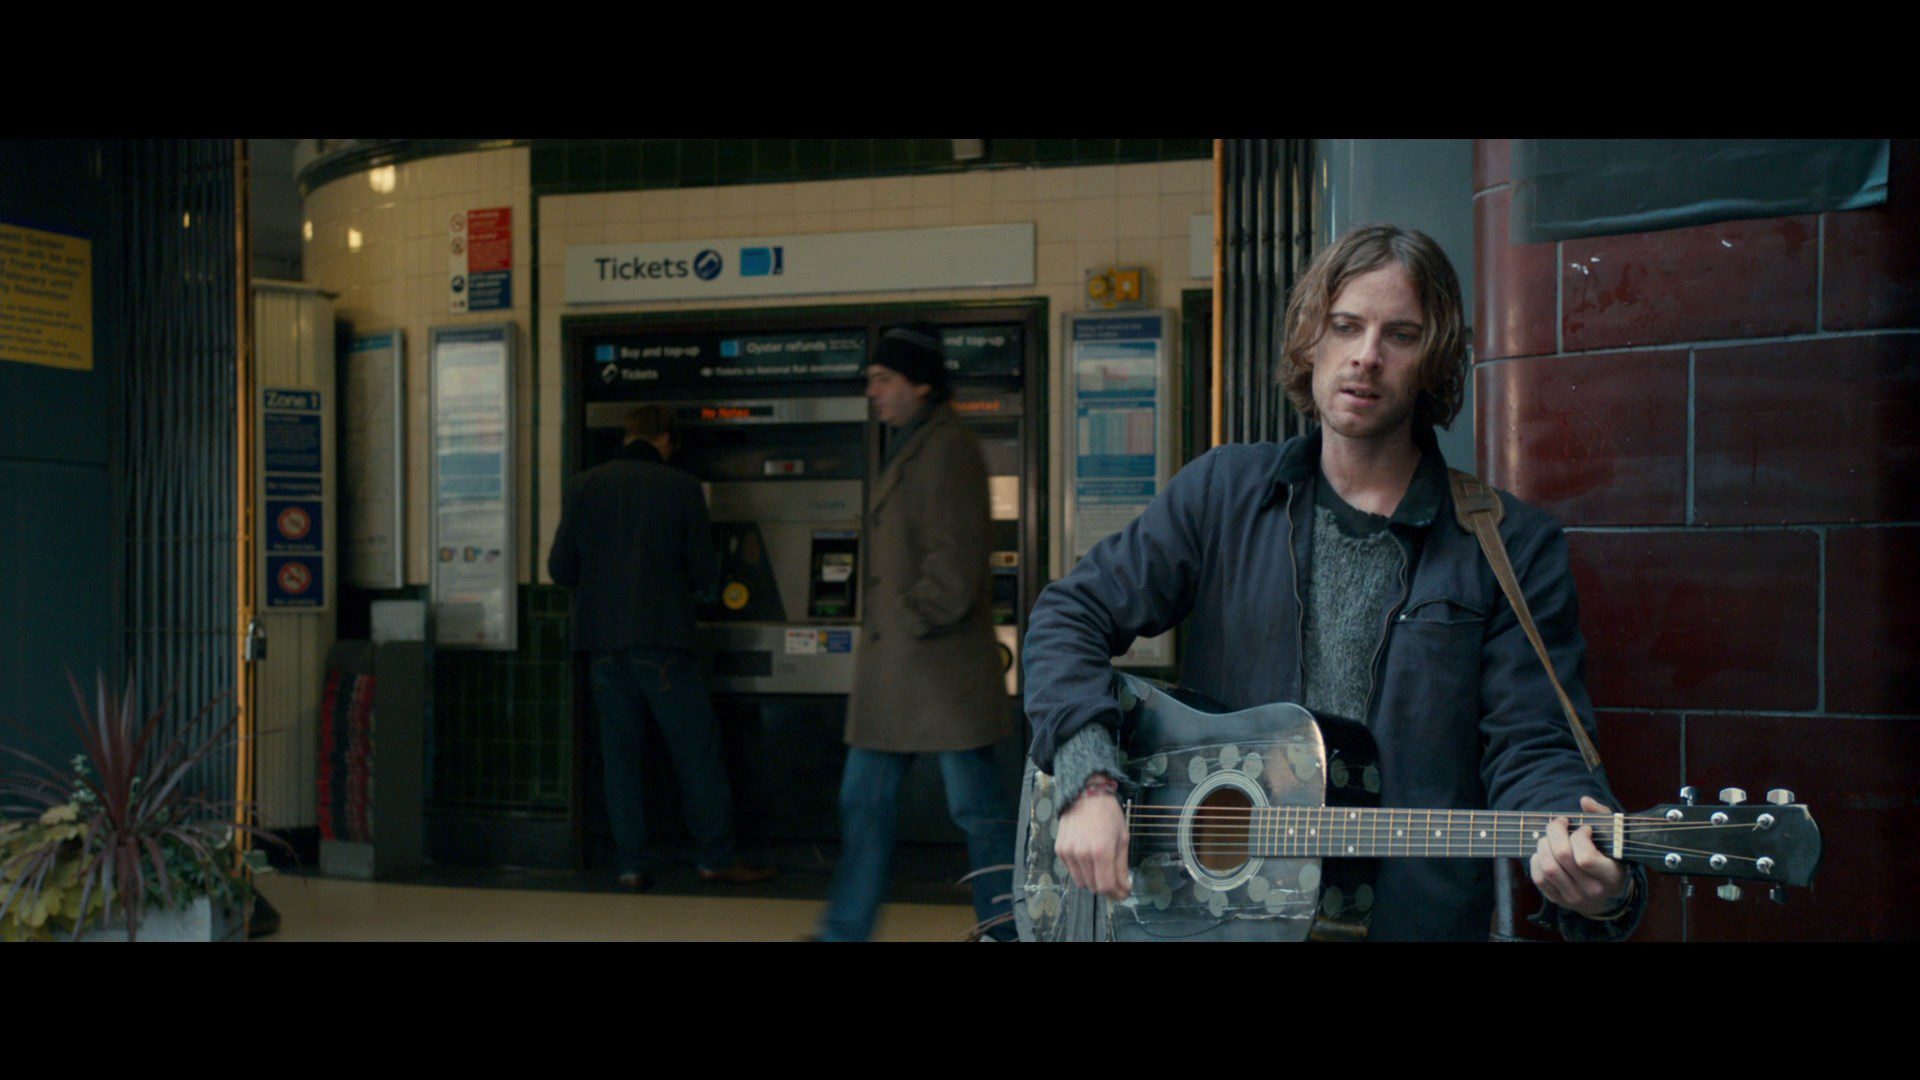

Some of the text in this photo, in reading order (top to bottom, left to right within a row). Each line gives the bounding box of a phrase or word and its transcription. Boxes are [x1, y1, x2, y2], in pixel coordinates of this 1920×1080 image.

[594, 257, 689, 281] Tickets
[620, 345, 700, 361] Buy and top-up
[746, 342, 782, 356] Oyster
[784, 340, 827, 352] refunds
[621, 368, 659, 381] Tickets
[266, 391, 318, 410] Zone 1
